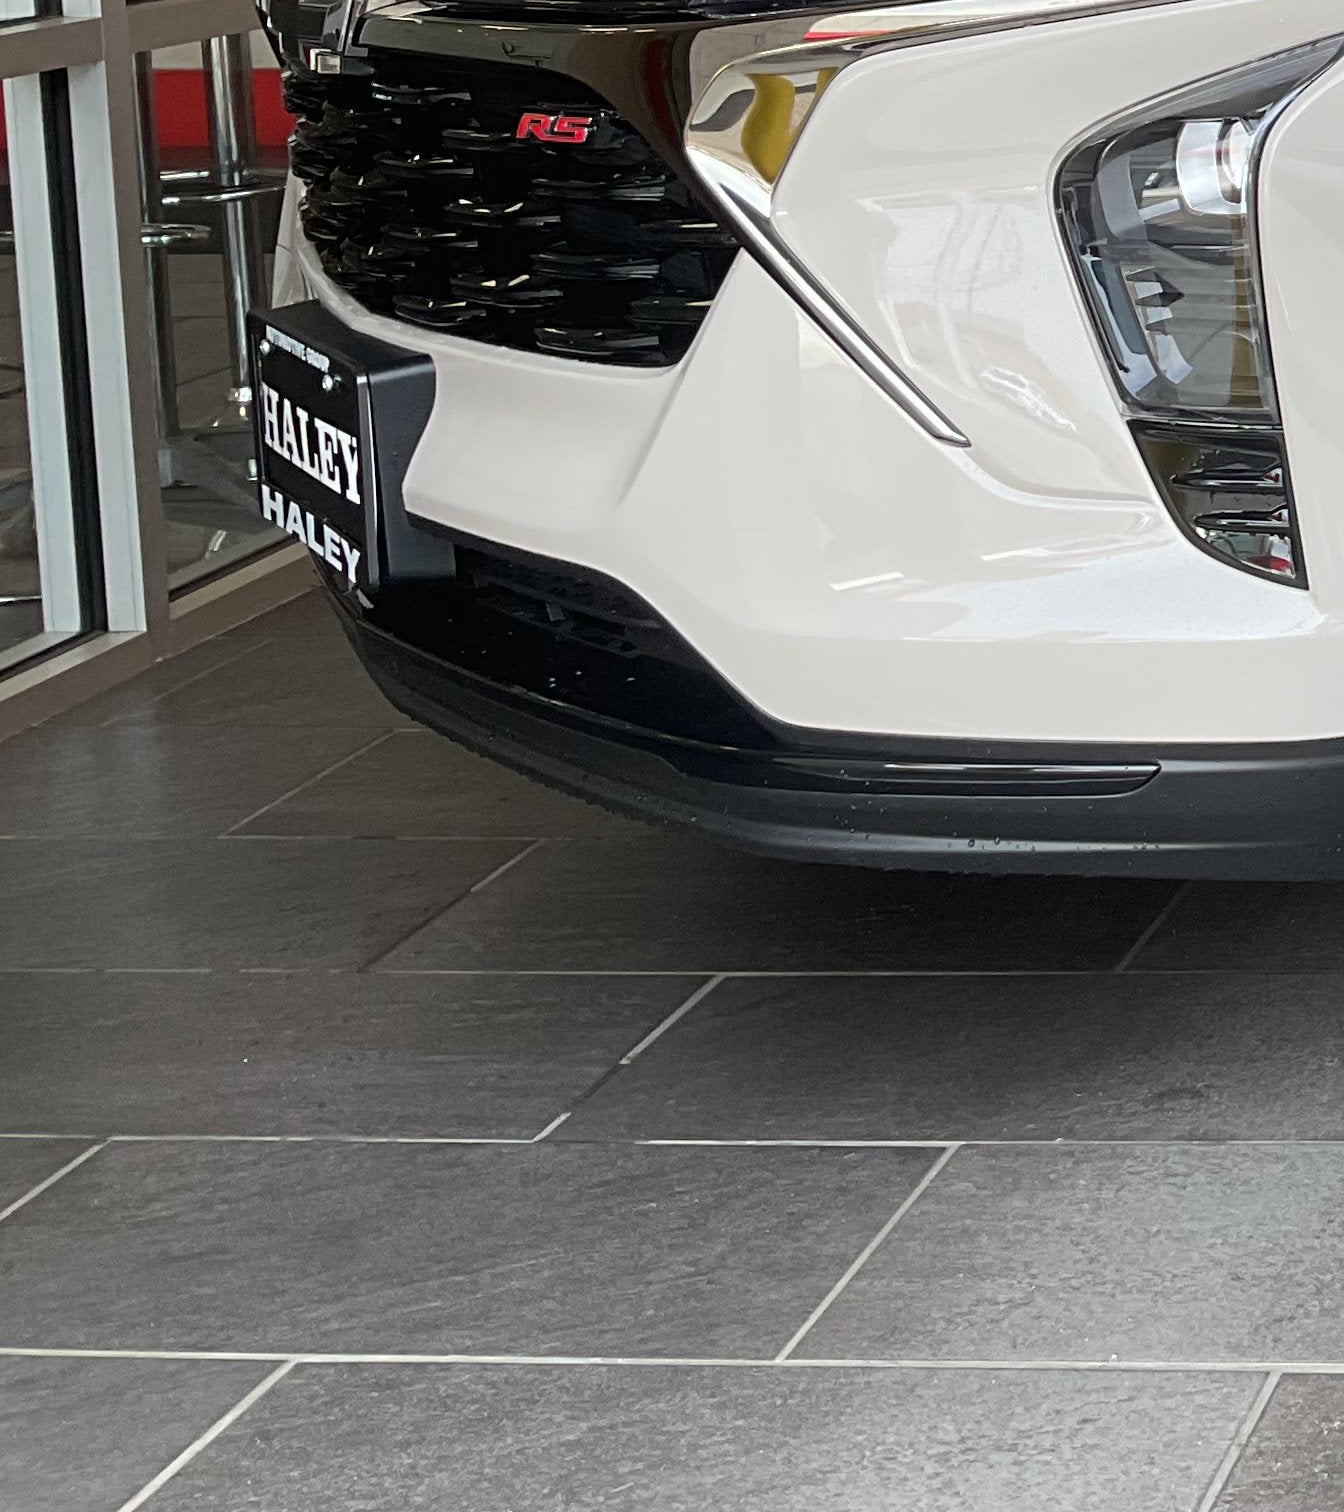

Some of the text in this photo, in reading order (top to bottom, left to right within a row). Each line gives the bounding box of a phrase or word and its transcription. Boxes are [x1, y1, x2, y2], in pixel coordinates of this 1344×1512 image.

[516, 112, 593, 143] RS
[262, 381, 361, 505] HALEY
[261, 484, 361, 584] HALEY
